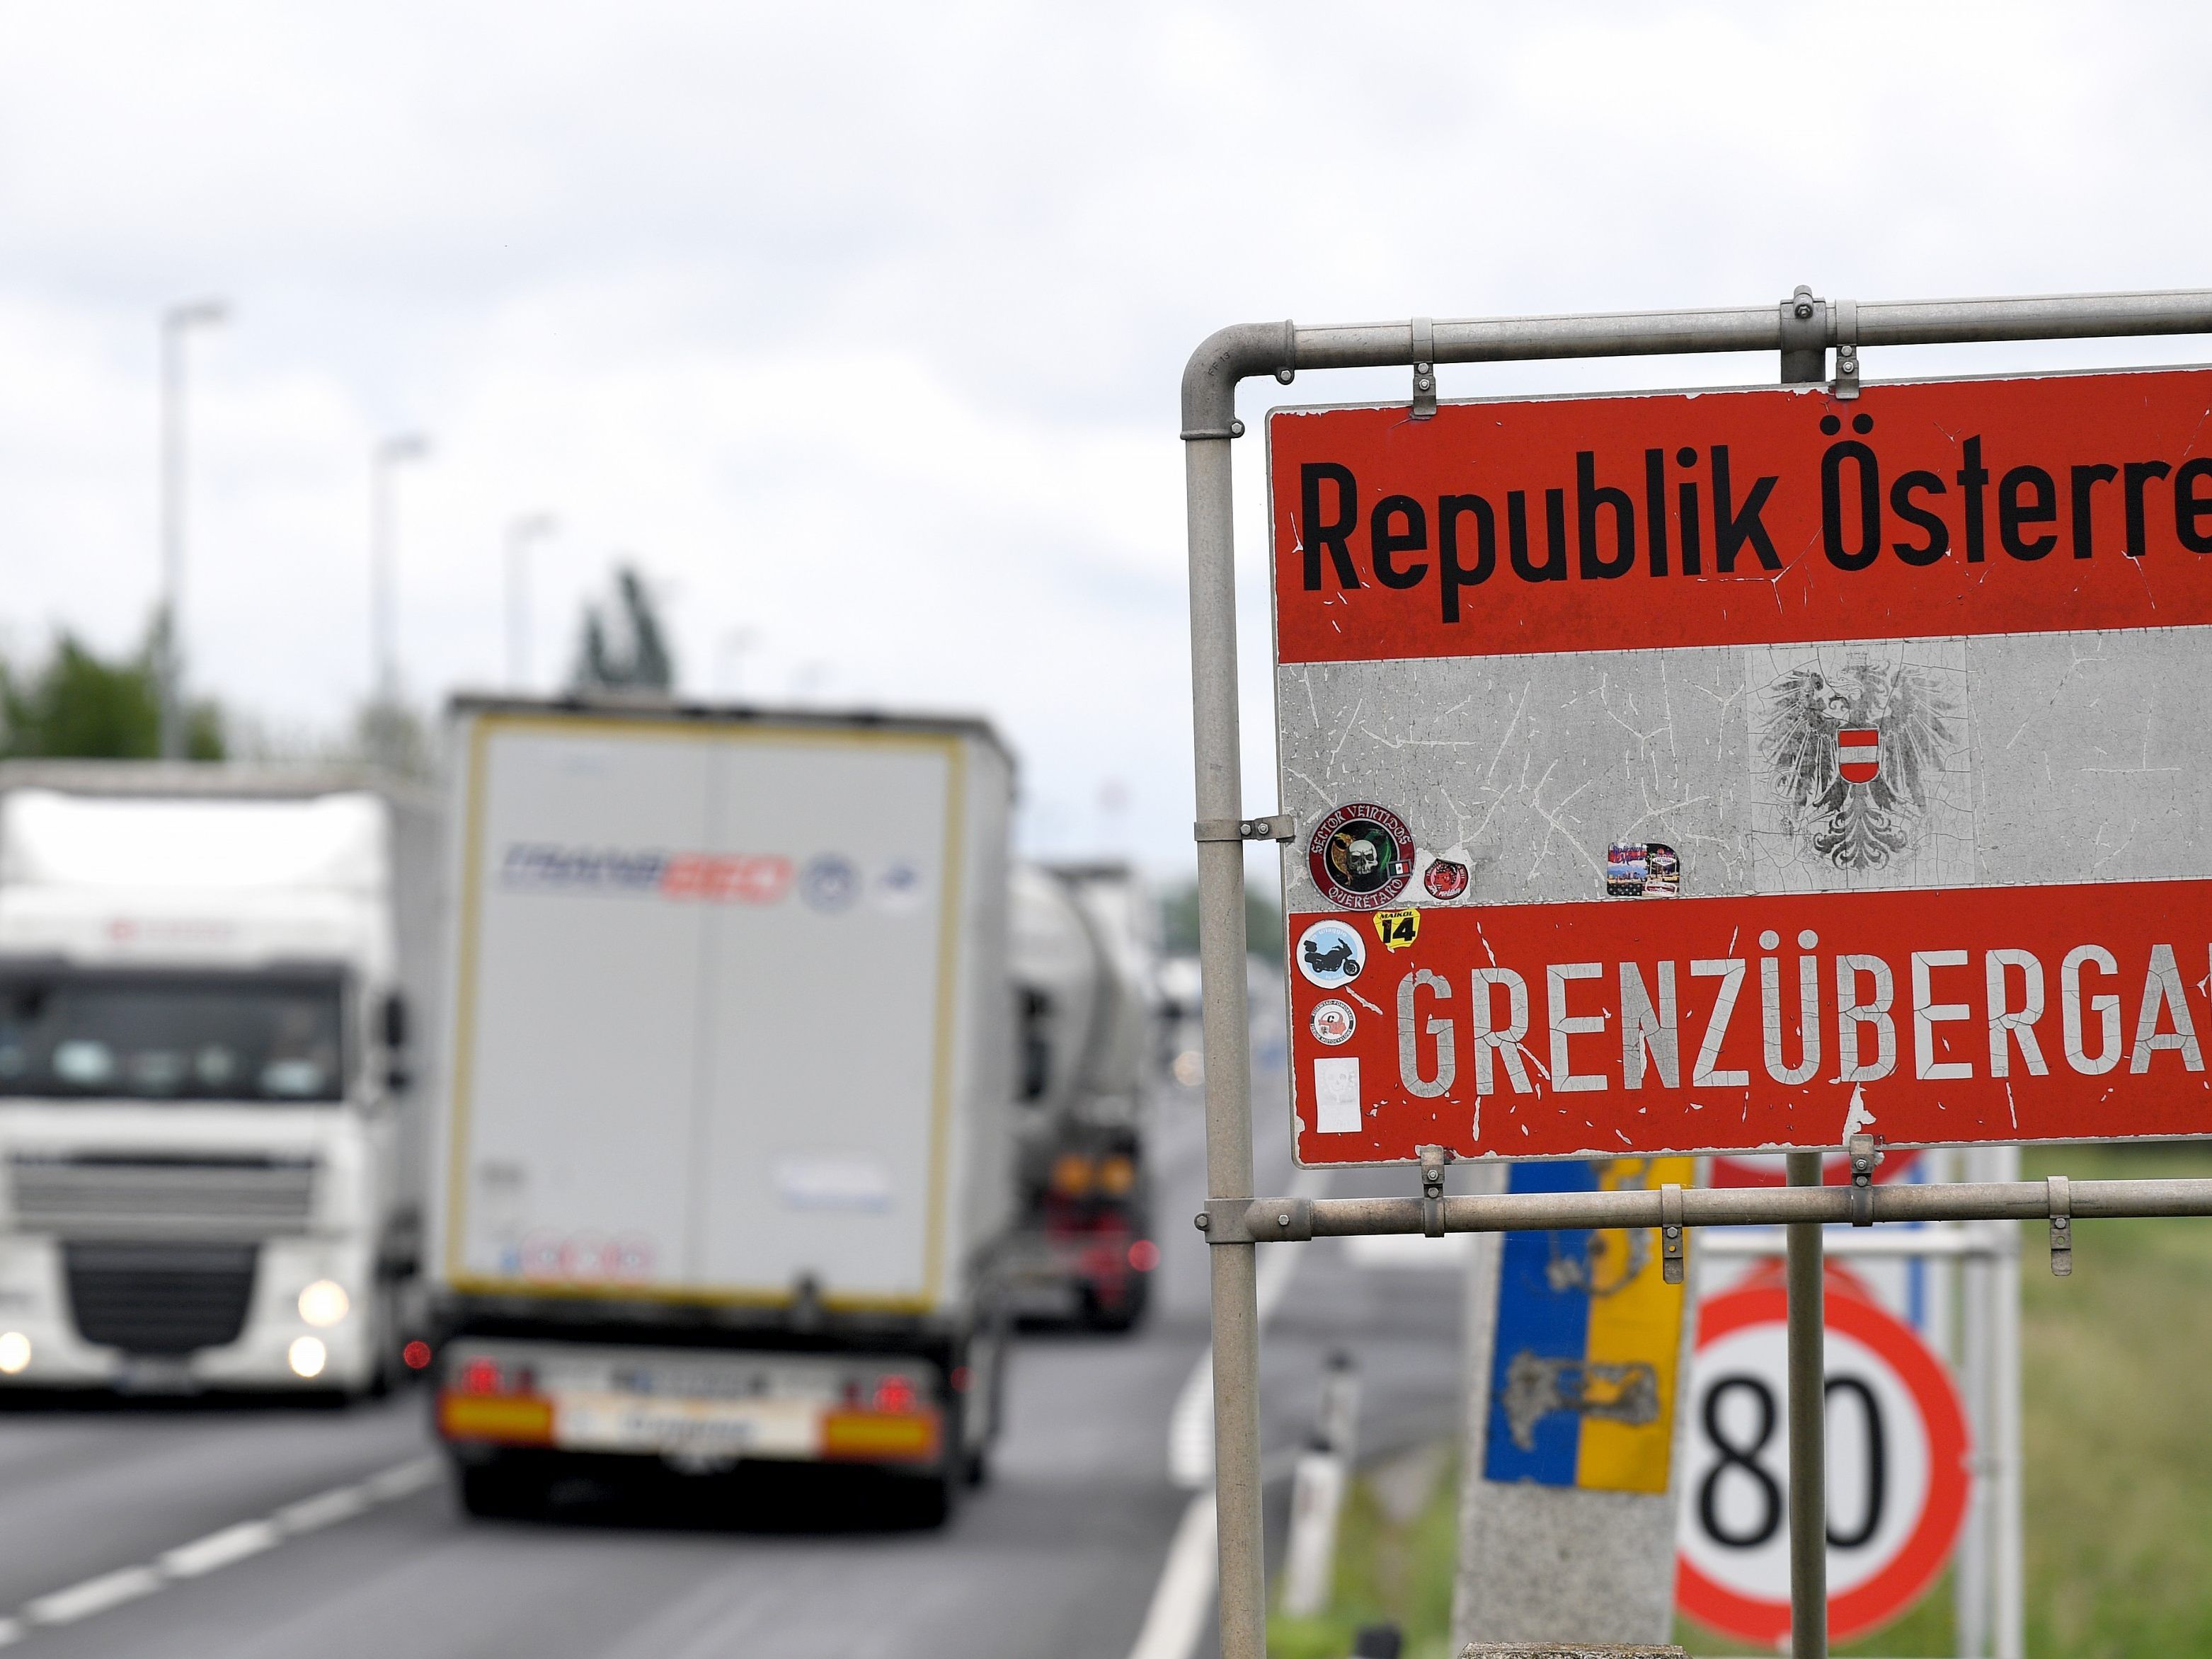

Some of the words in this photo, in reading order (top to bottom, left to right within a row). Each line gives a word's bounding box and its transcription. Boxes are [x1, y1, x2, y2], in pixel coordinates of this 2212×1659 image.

[1300, 444, 1784, 623] Republik
[1311, 810, 1346, 855] SECTOR
[1380, 910, 1414, 919] MAIKOL
[1382, 918, 1416, 943] 14
[1397, 929, 2212, 1098] GRENZÜBERGA
[1697, 1374, 1887, 1549] 80
